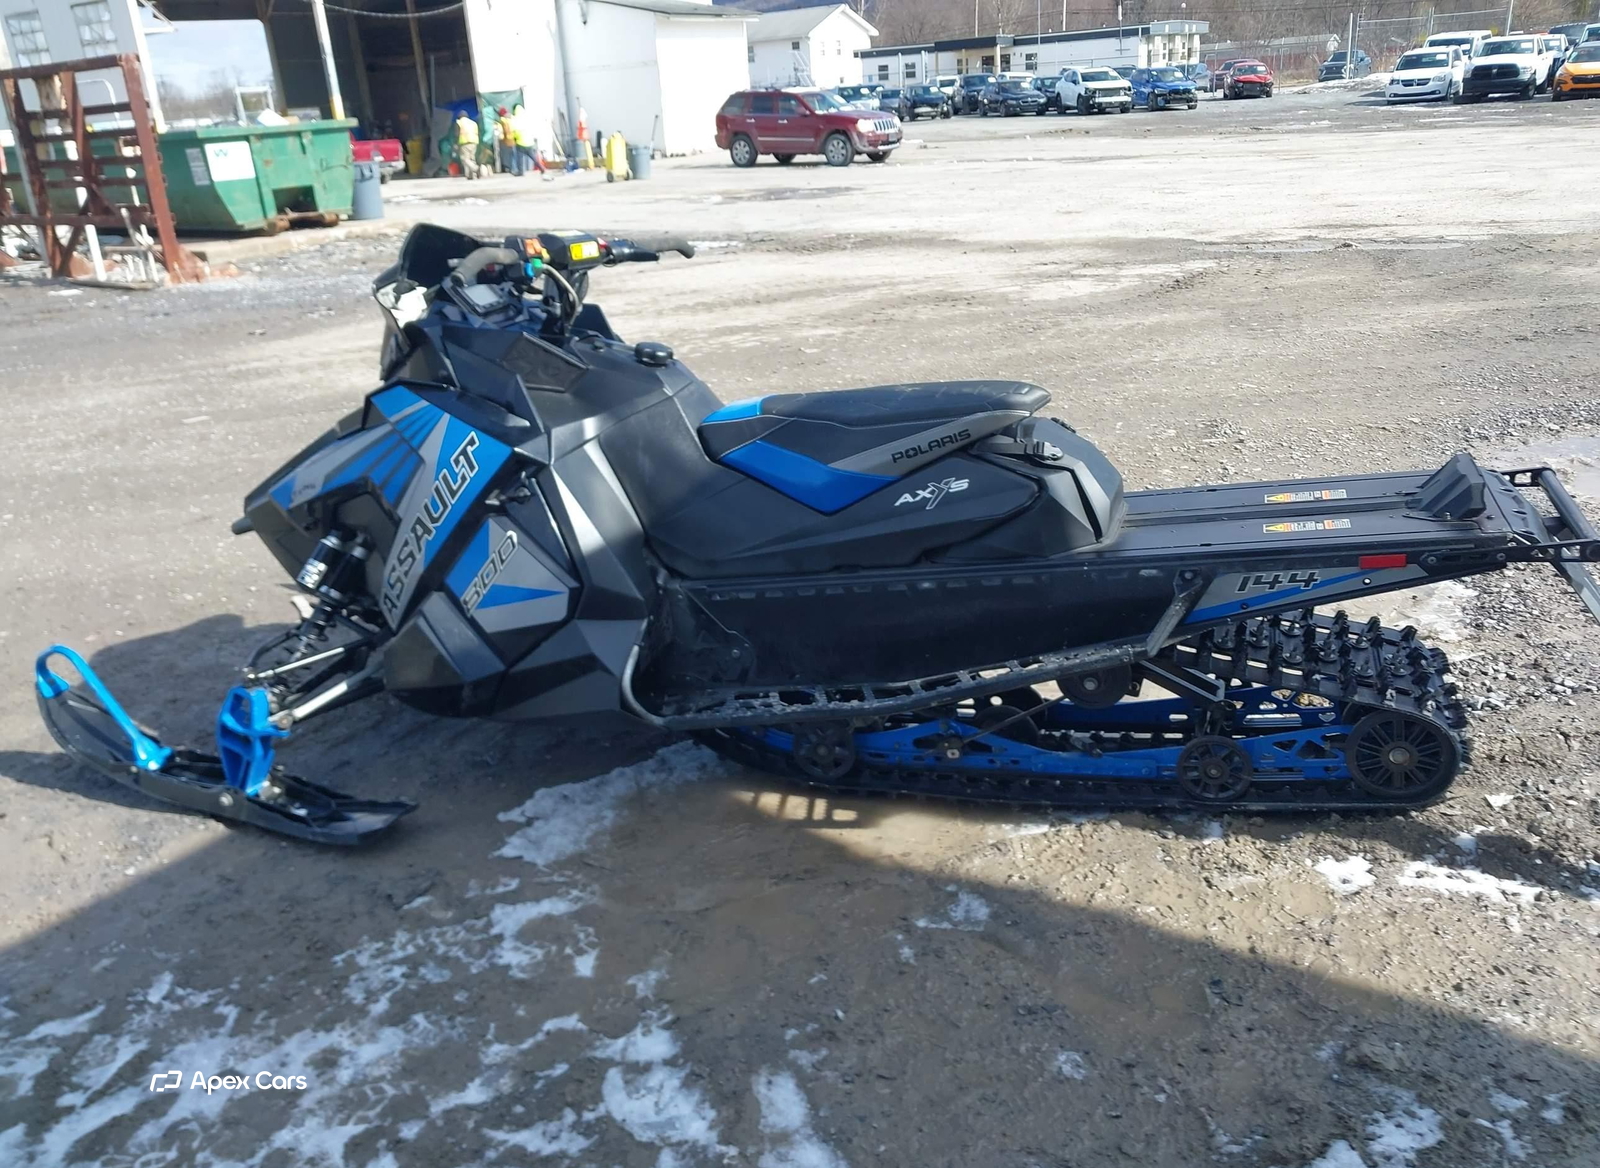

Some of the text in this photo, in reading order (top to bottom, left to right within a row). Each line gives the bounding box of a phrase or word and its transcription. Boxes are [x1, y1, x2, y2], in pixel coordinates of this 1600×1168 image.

[891, 429, 972, 463] POLARIS
[382, 431, 480, 614] ASSAULT
[460, 530, 518, 616] 800
[1235, 571, 1321, 593] 144
